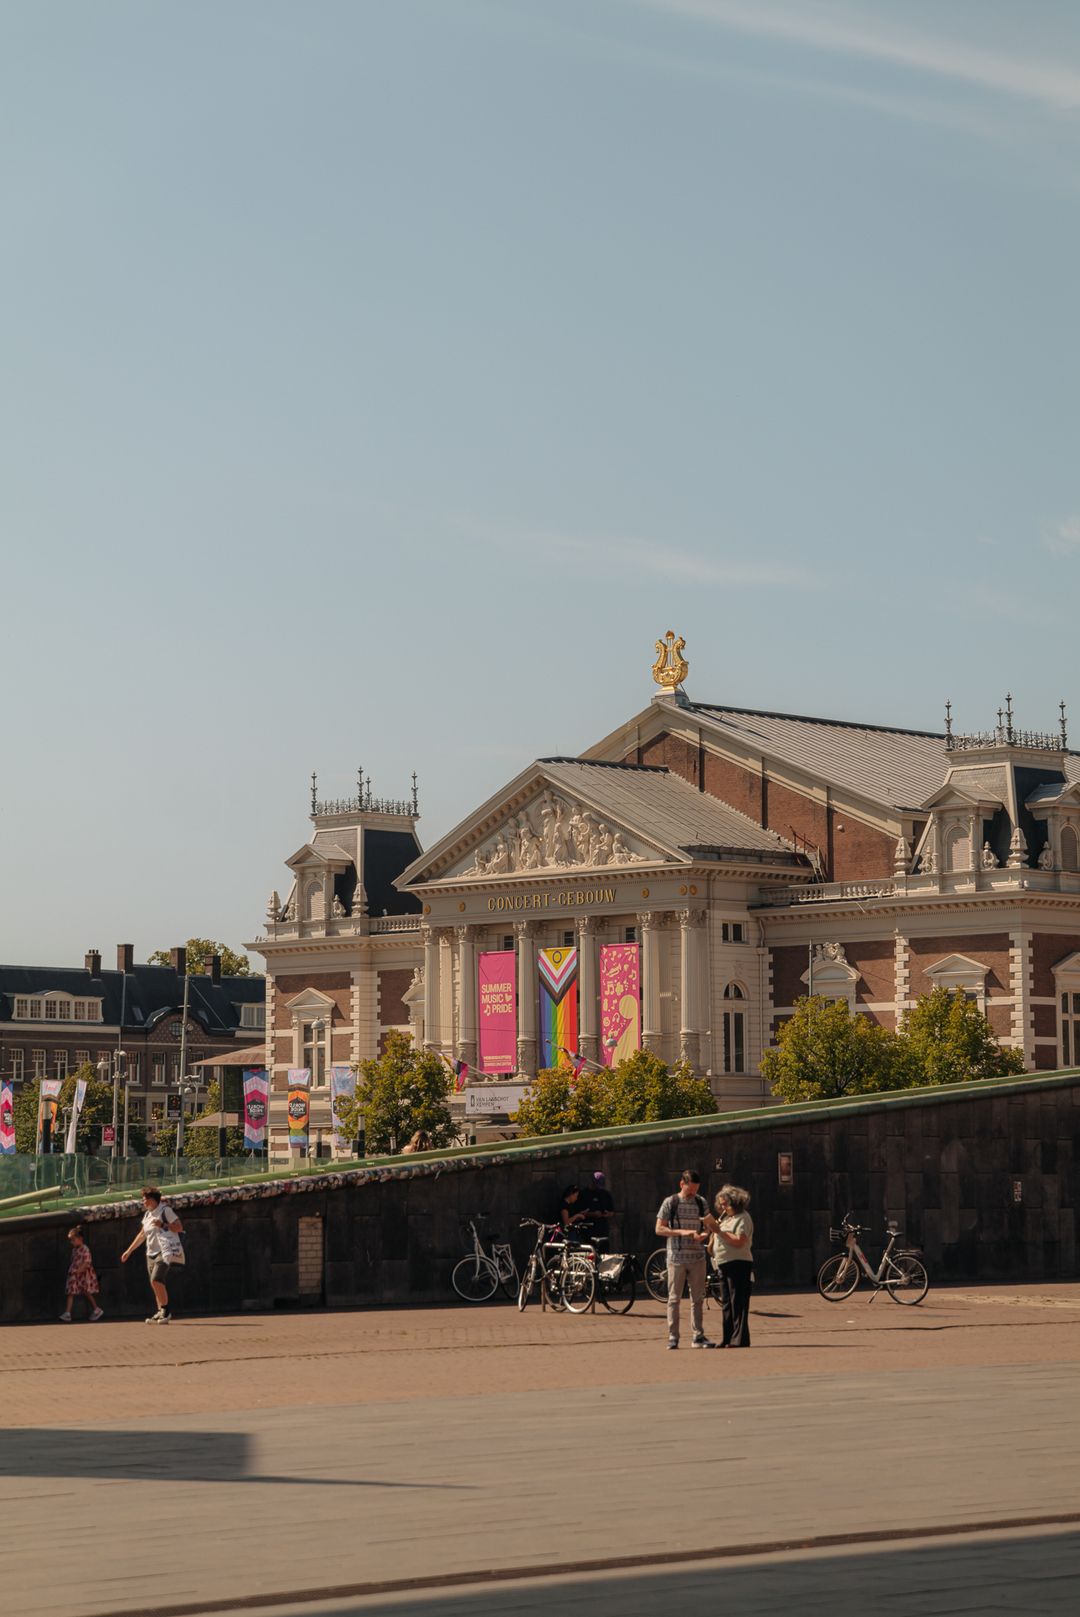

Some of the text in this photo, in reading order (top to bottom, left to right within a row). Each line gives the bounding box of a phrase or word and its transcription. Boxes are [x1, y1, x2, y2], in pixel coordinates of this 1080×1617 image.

[482, 983, 512, 993] SUMMER
[482, 994, 504, 1004] MUSIC
[492, 1004, 512, 1014] PRIDE
